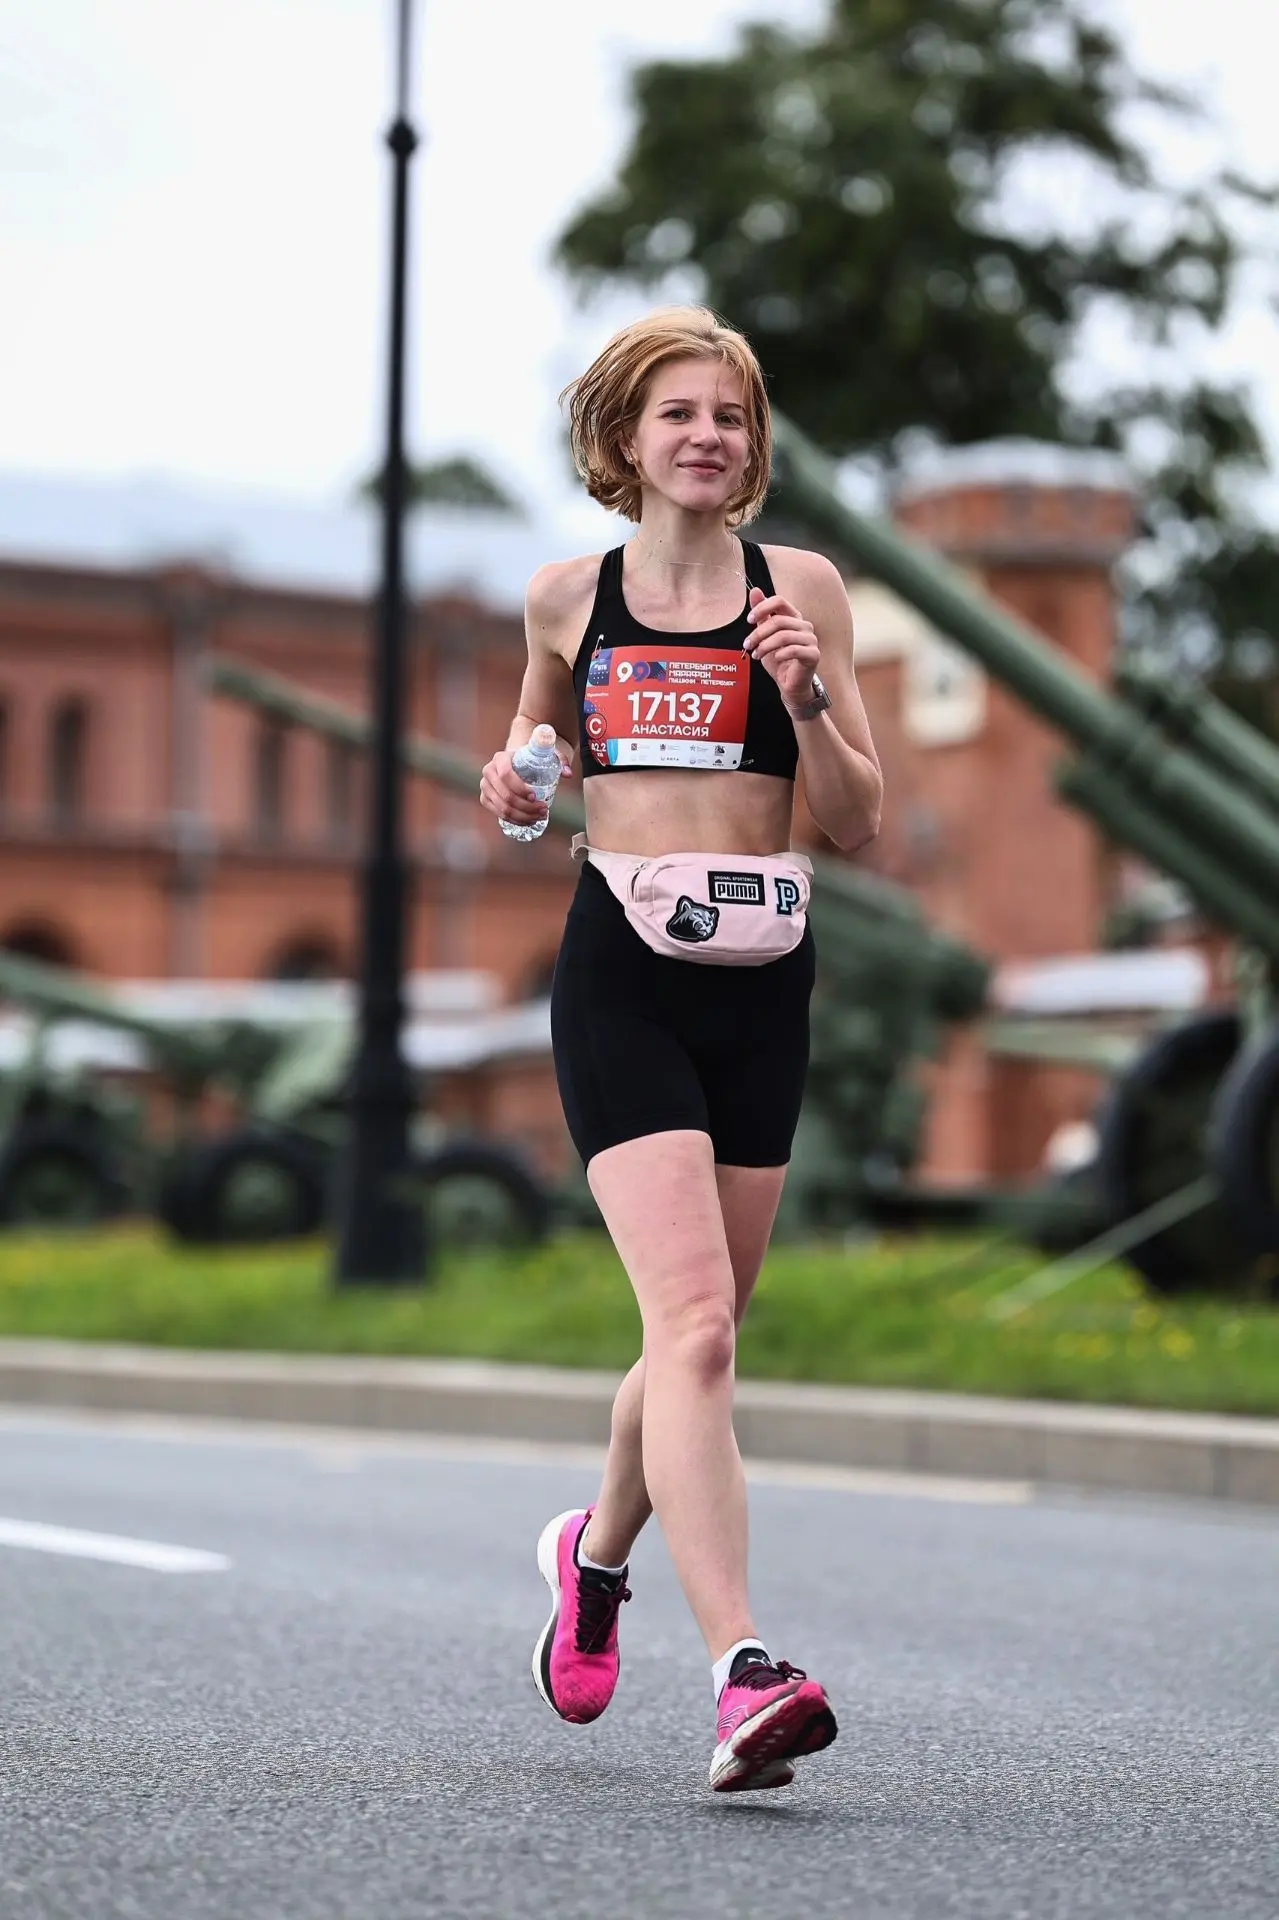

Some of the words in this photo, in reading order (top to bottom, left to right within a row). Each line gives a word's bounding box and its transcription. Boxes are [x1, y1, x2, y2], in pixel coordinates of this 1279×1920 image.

[669, 661, 737, 672] ПЕТЕРБУРГСКИЙ
[668, 670, 711, 678] МАРАФОН
[627, 691, 722, 724] 17137
[631, 725, 710, 737] АНАСТАСИЯ
[717, 883, 757, 899] PUMA
[774, 877, 800, 915] P
